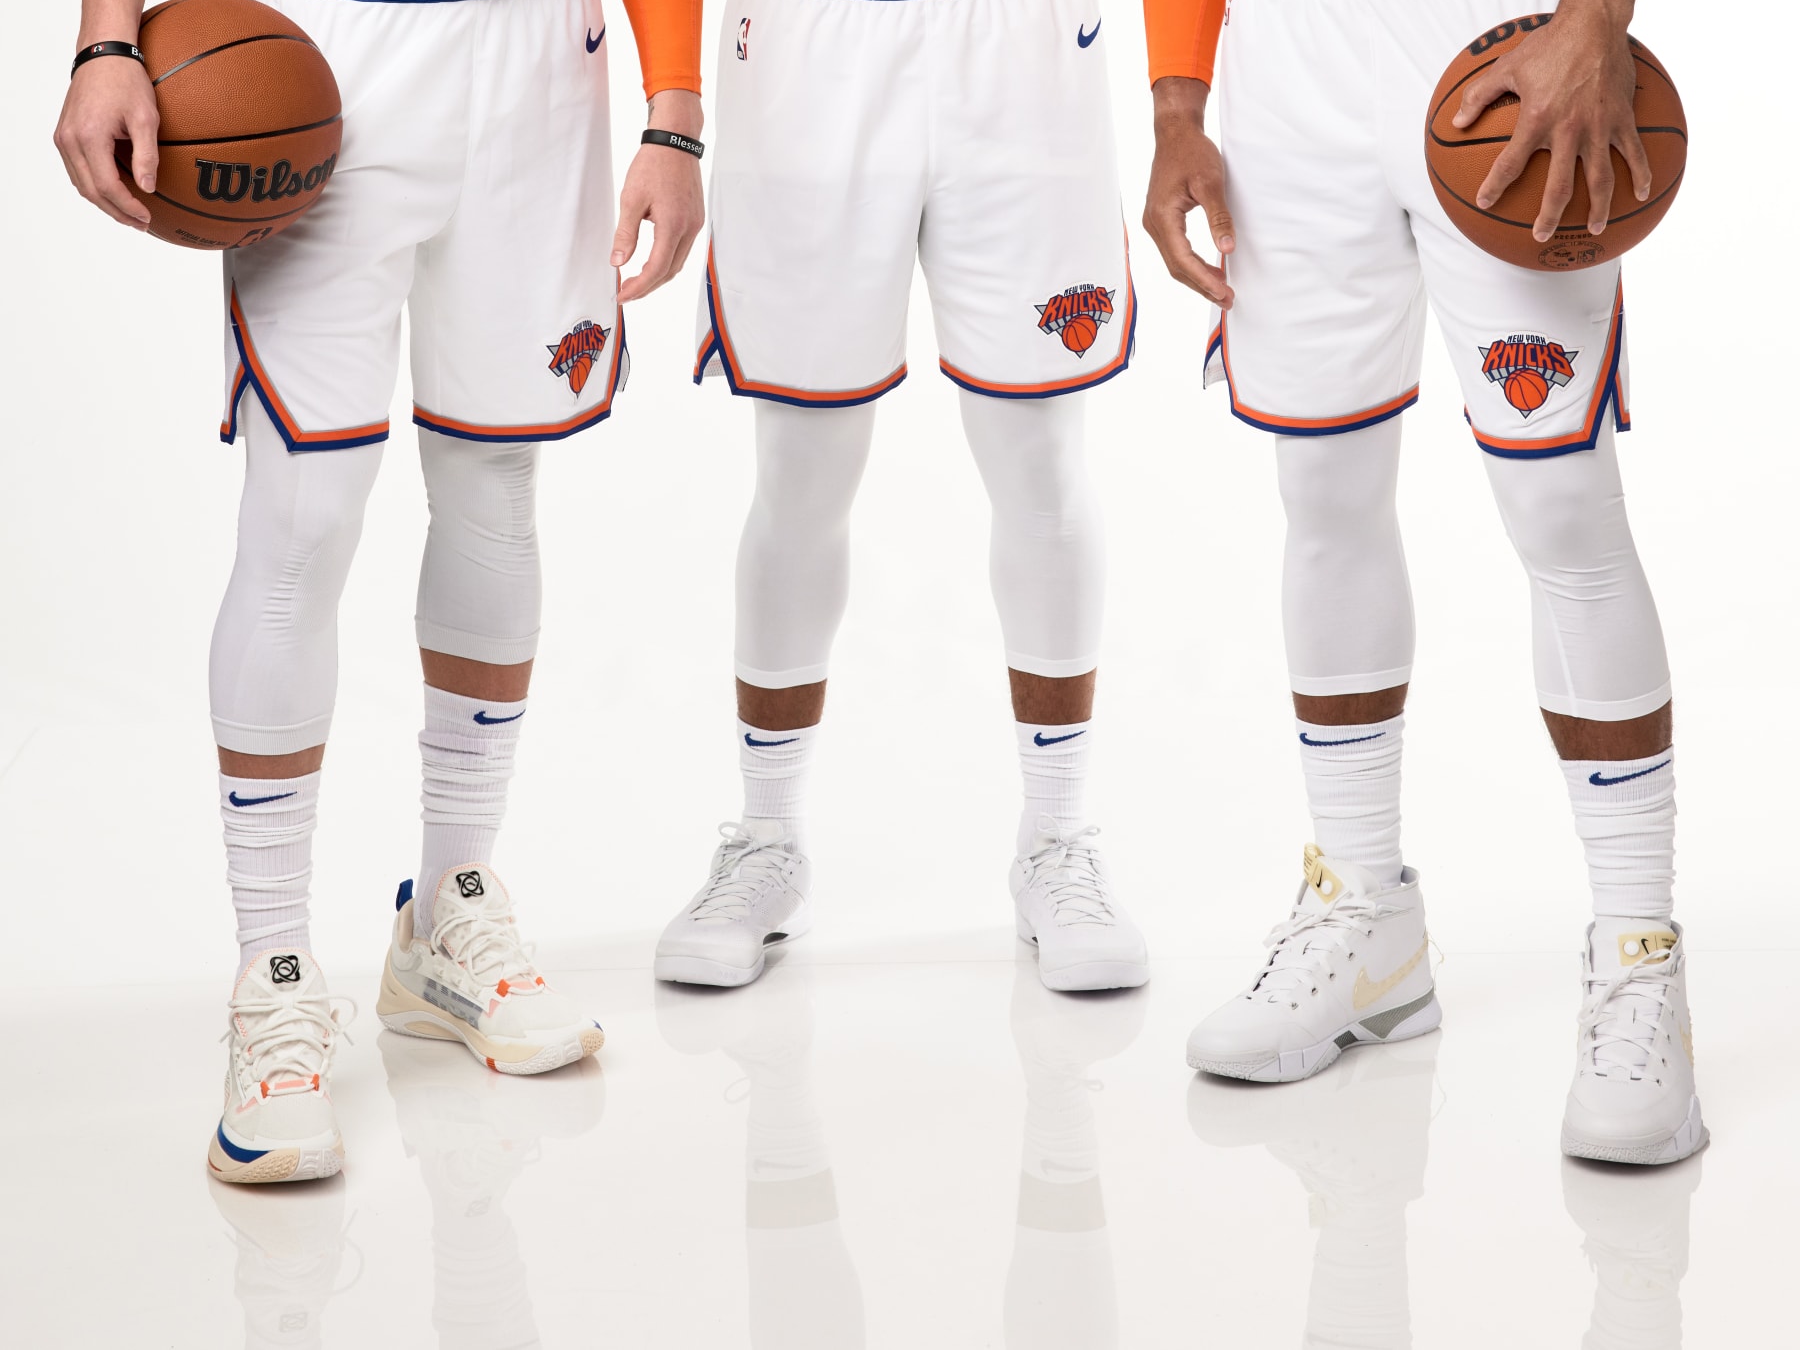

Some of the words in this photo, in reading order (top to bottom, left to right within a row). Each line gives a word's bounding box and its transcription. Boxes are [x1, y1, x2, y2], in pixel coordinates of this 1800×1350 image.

[669, 135, 703, 154] Blessed
[195, 152, 336, 202] Wilson
[1038, 286, 1114, 328] KNICKS
[548, 323, 606, 369] KNICKS
[1482, 339, 1575, 379] KNICKS
[1507, 334, 1525, 343] NEW
[1525, 334, 1547, 344] YORK
